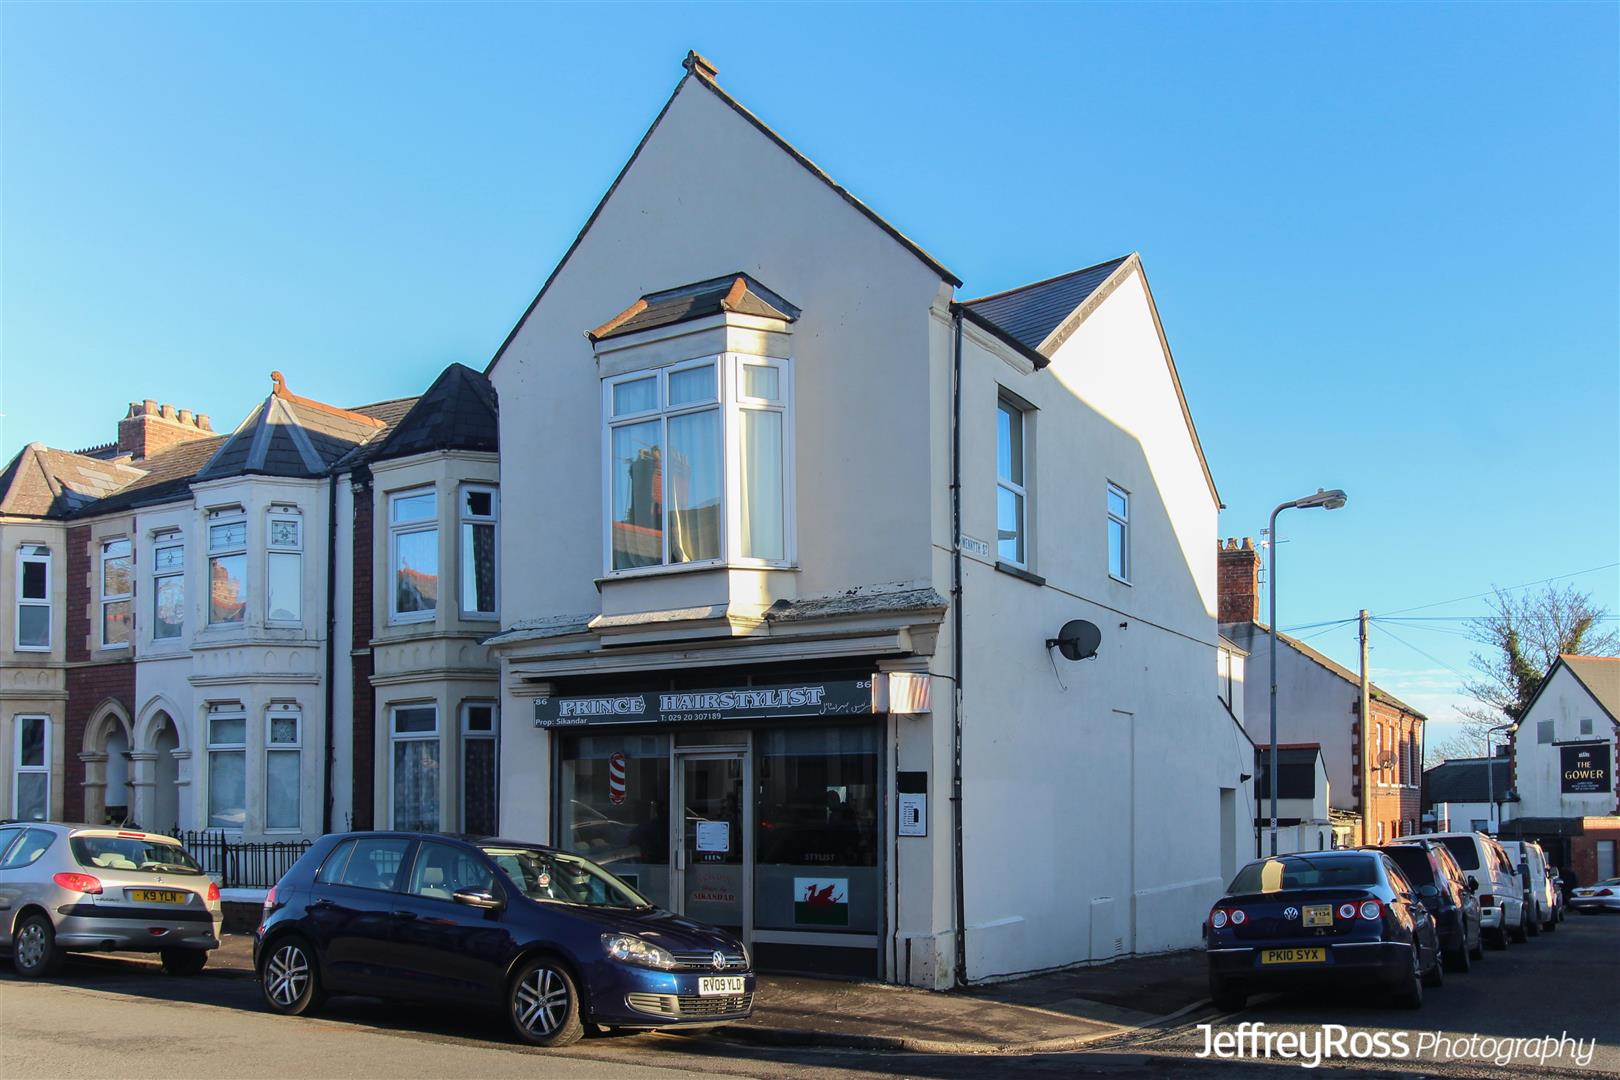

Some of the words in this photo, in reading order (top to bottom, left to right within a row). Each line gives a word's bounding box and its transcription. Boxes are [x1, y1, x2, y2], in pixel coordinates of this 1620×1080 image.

[855, 681, 871, 689] 86
[535, 698, 548, 706] 86
[559, 695, 647, 716] PRINCE
[660, 686, 825, 712] HAIRSTYLIST
[535, 718, 554, 727] Prop:
[556, 717, 588, 726] Sikandar
[660, 714, 667, 722] T:
[683, 713, 693, 721] 20
[694, 712, 722, 721] 307189
[1564, 769, 1604, 780] GOWER
[143, 891, 156, 901] K9
[160, 892, 177, 902] YLN
[1268, 950, 1294, 961] PK10
[1296, 949, 1319, 960] SYX
[703, 979, 725, 991] RV09
[726, 978, 742, 990] YLD
